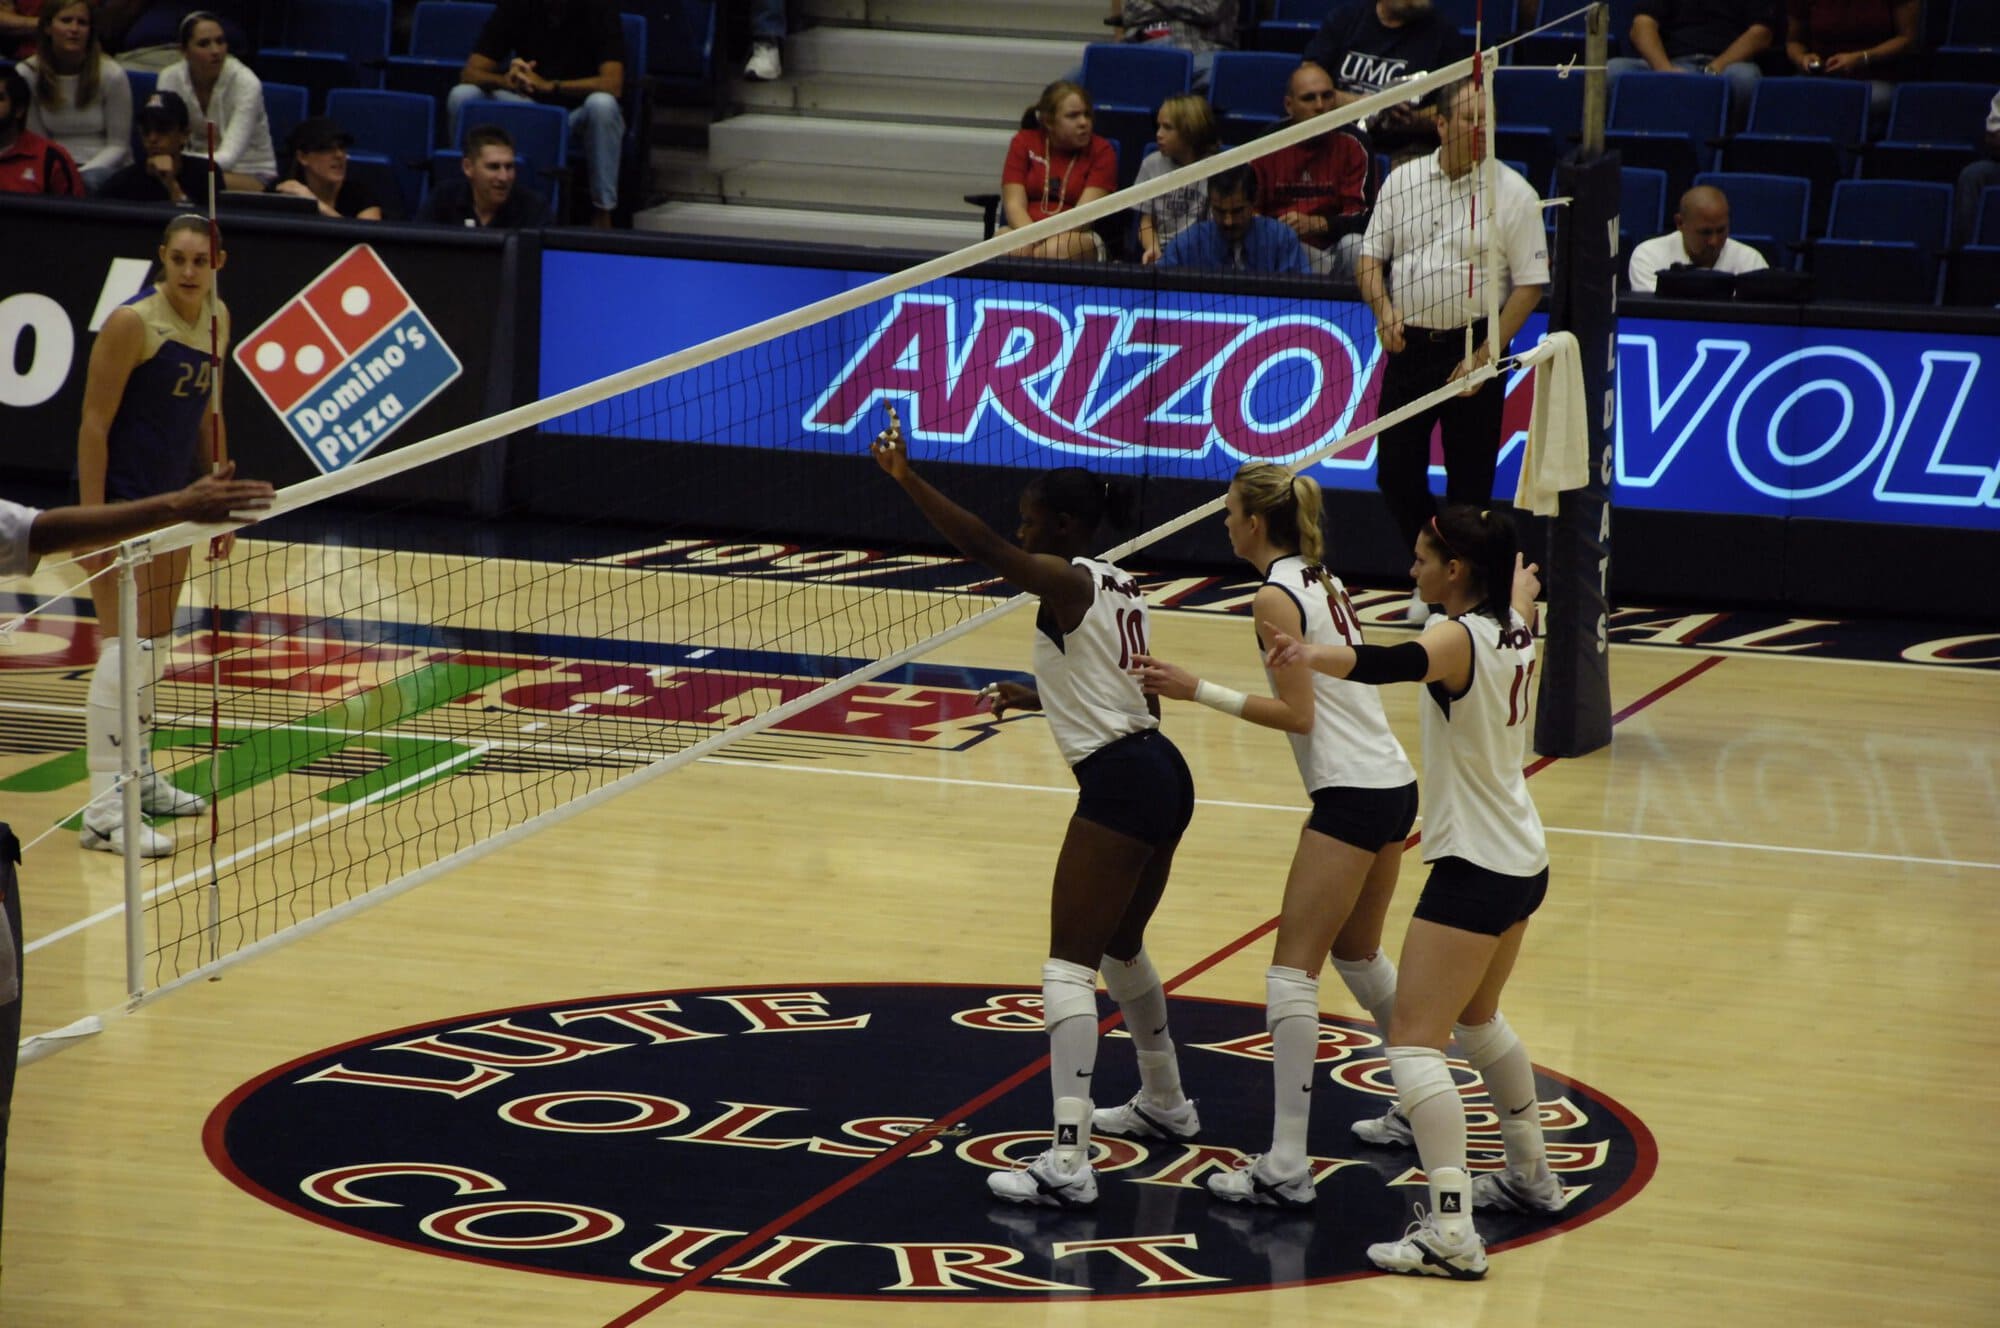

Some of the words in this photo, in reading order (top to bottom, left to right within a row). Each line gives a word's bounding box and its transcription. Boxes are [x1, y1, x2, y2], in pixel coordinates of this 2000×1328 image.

[1340, 53, 1406, 86] UMC
[171, 361, 212, 397] 24
[293, 322, 428, 441] Domino's
[315, 394, 405, 467] Pizza
[571, 538, 968, 582] 1997
[294, 991, 871, 1100] LUTE
[951, 992, 1133, 1038] &
[497, 1089, 1369, 1190] OLSON
[299, 1161, 1231, 1291] COURT
